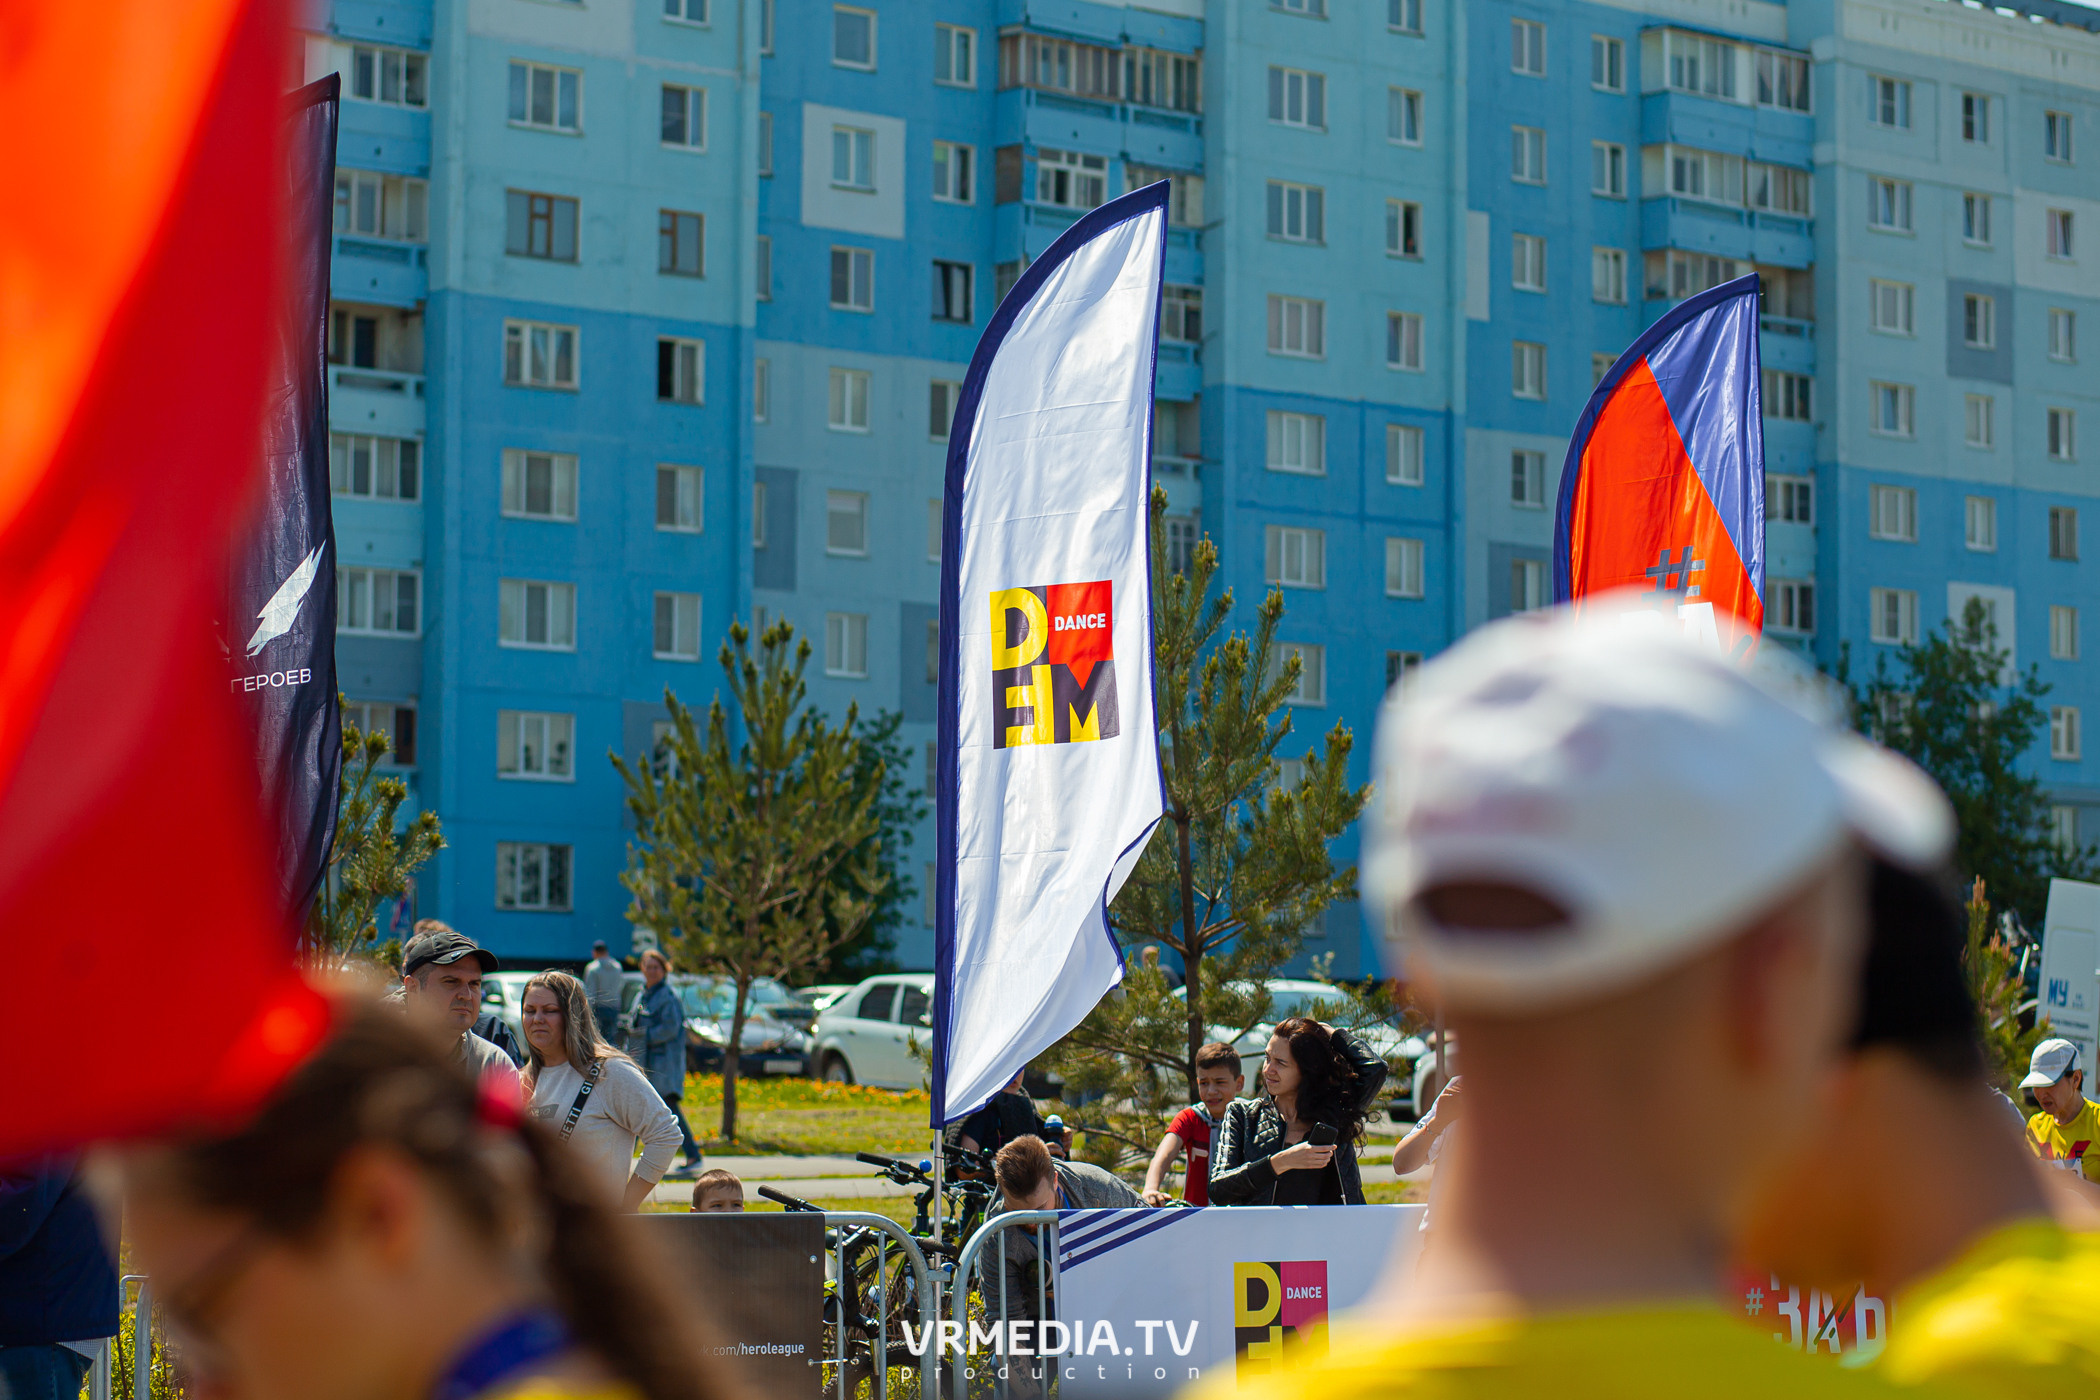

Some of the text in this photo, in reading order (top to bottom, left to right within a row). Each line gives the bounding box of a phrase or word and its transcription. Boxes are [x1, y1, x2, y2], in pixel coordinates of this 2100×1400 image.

[1054, 613, 1107, 632] DANCE
[231, 668, 312, 693] ГЕРОЕВ
[1286, 1286, 1322, 1300] DANCE
